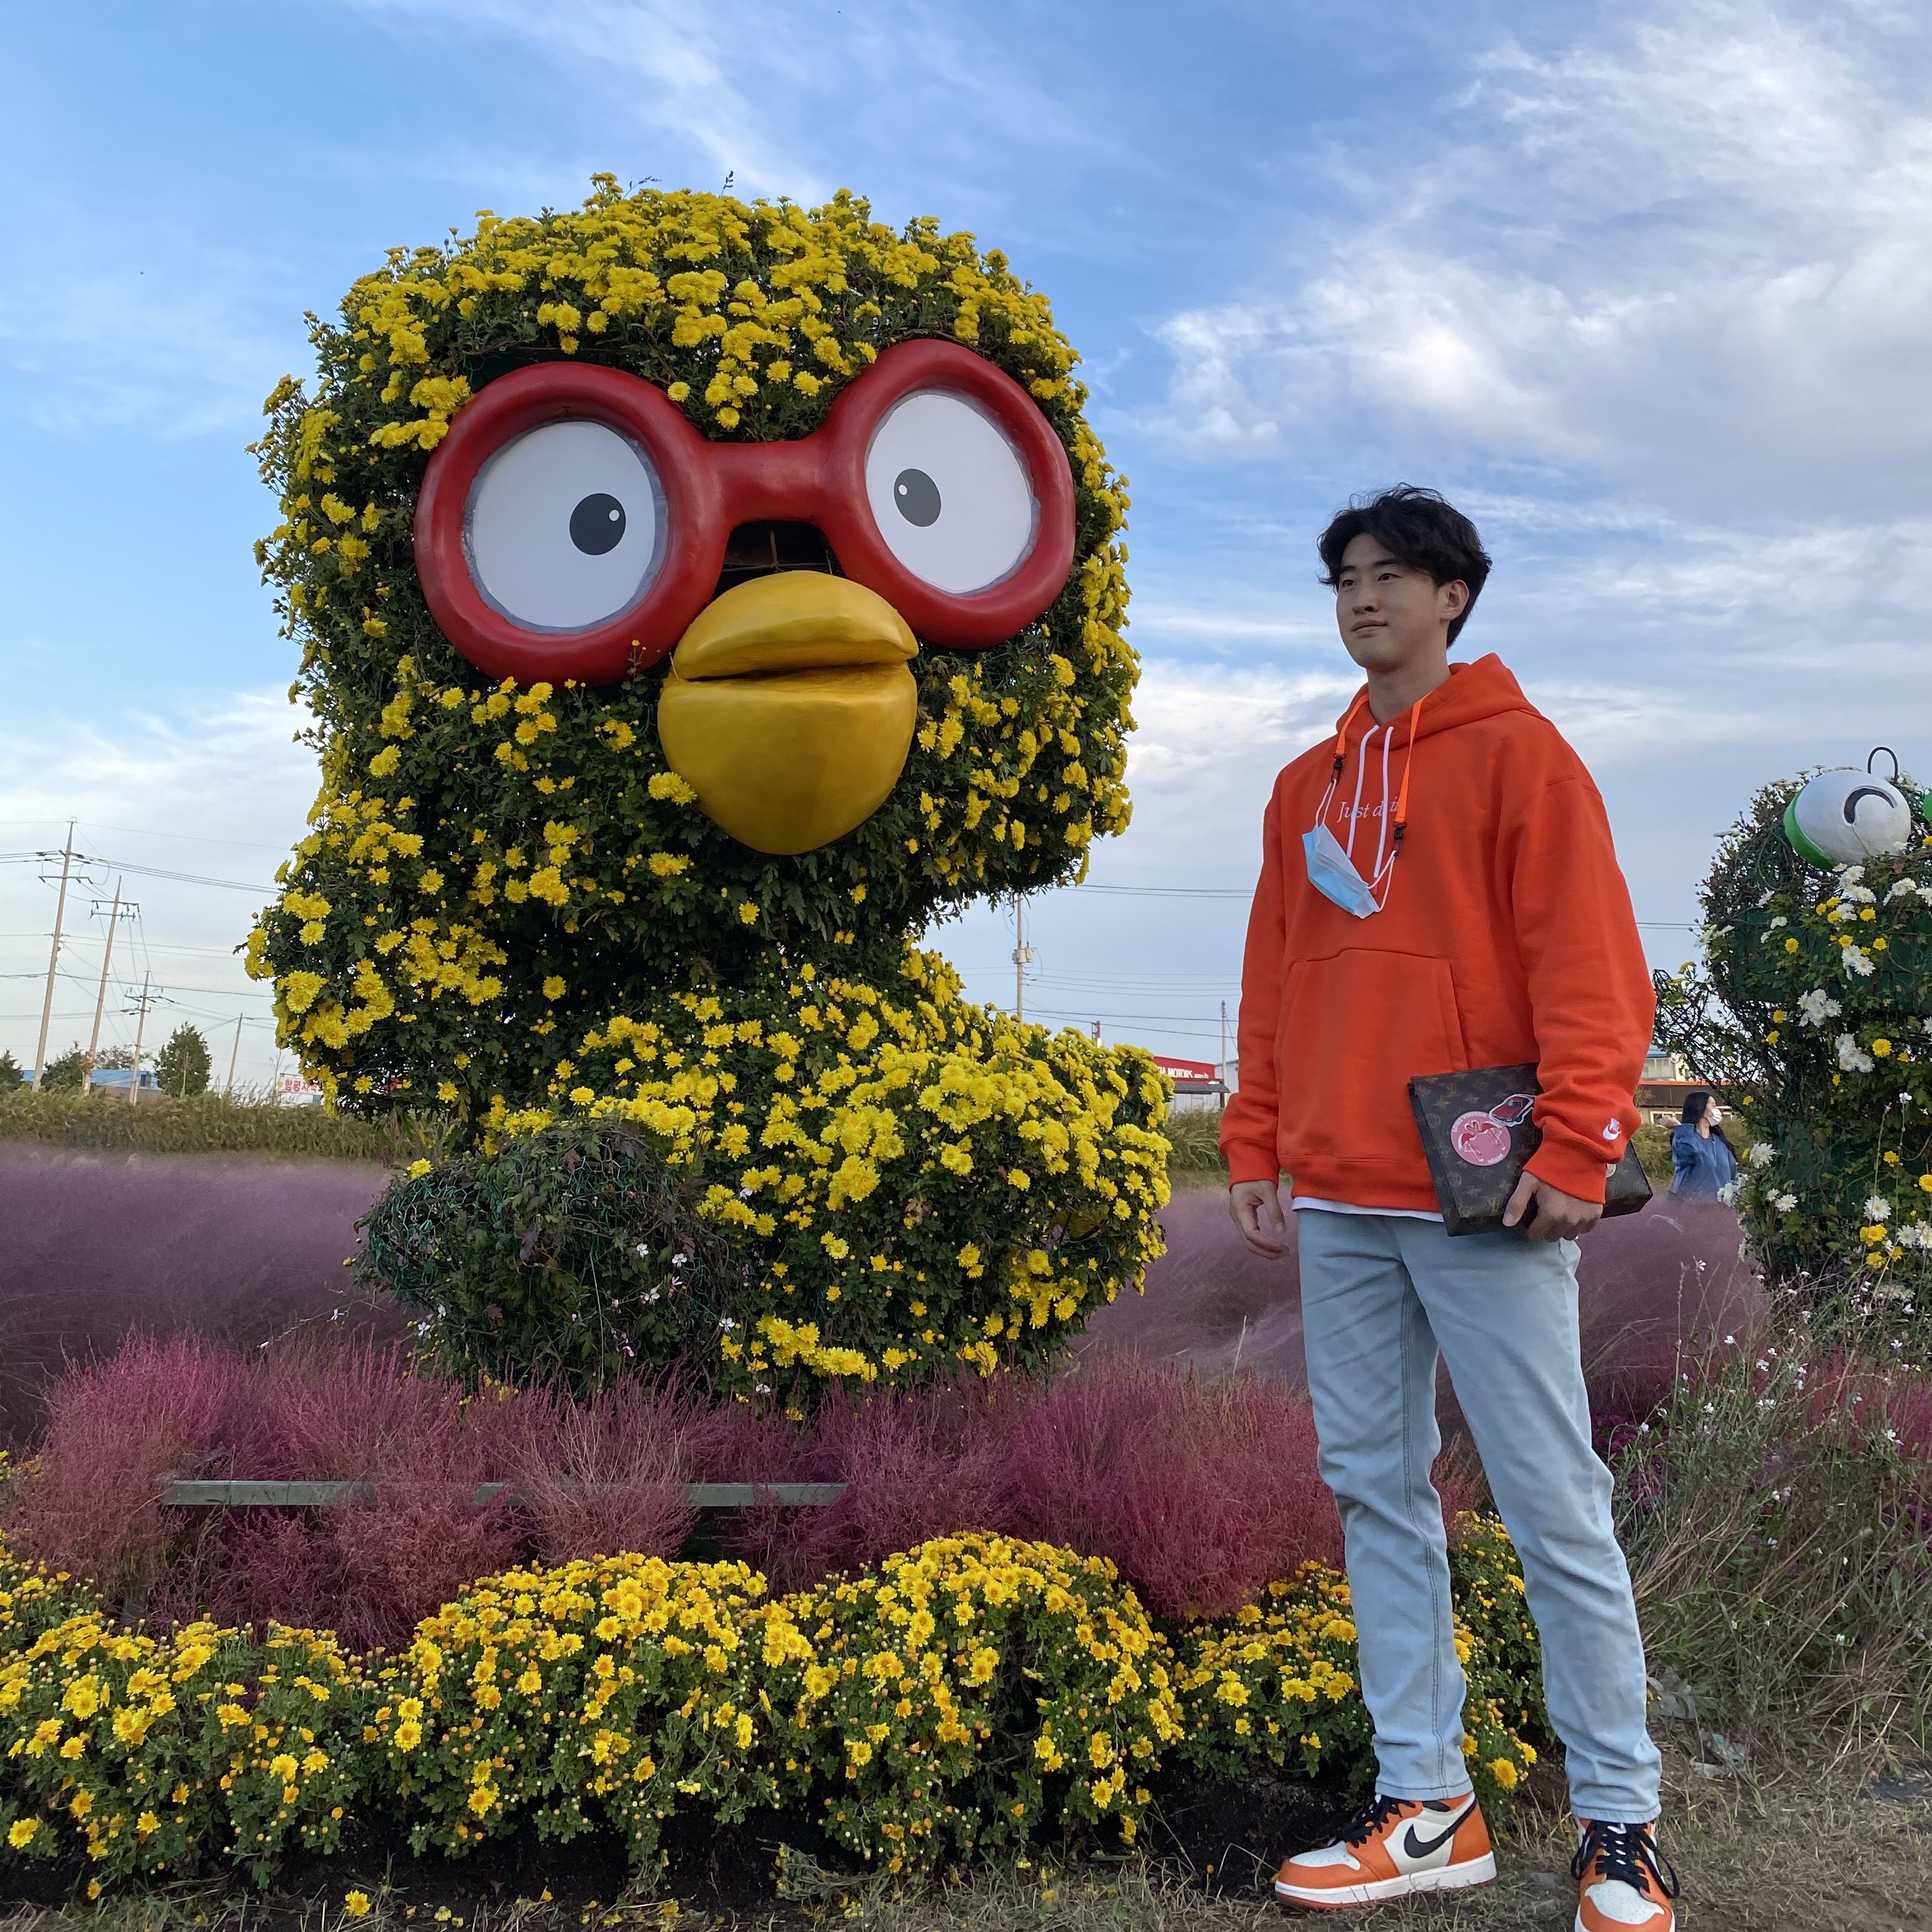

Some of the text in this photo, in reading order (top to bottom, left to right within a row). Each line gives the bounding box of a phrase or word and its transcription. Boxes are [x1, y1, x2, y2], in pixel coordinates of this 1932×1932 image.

[1337, 801, 1370, 823] Just
[1372, 800, 1387, 817] d
[1167, 1067, 1193, 1078] MOTORS
